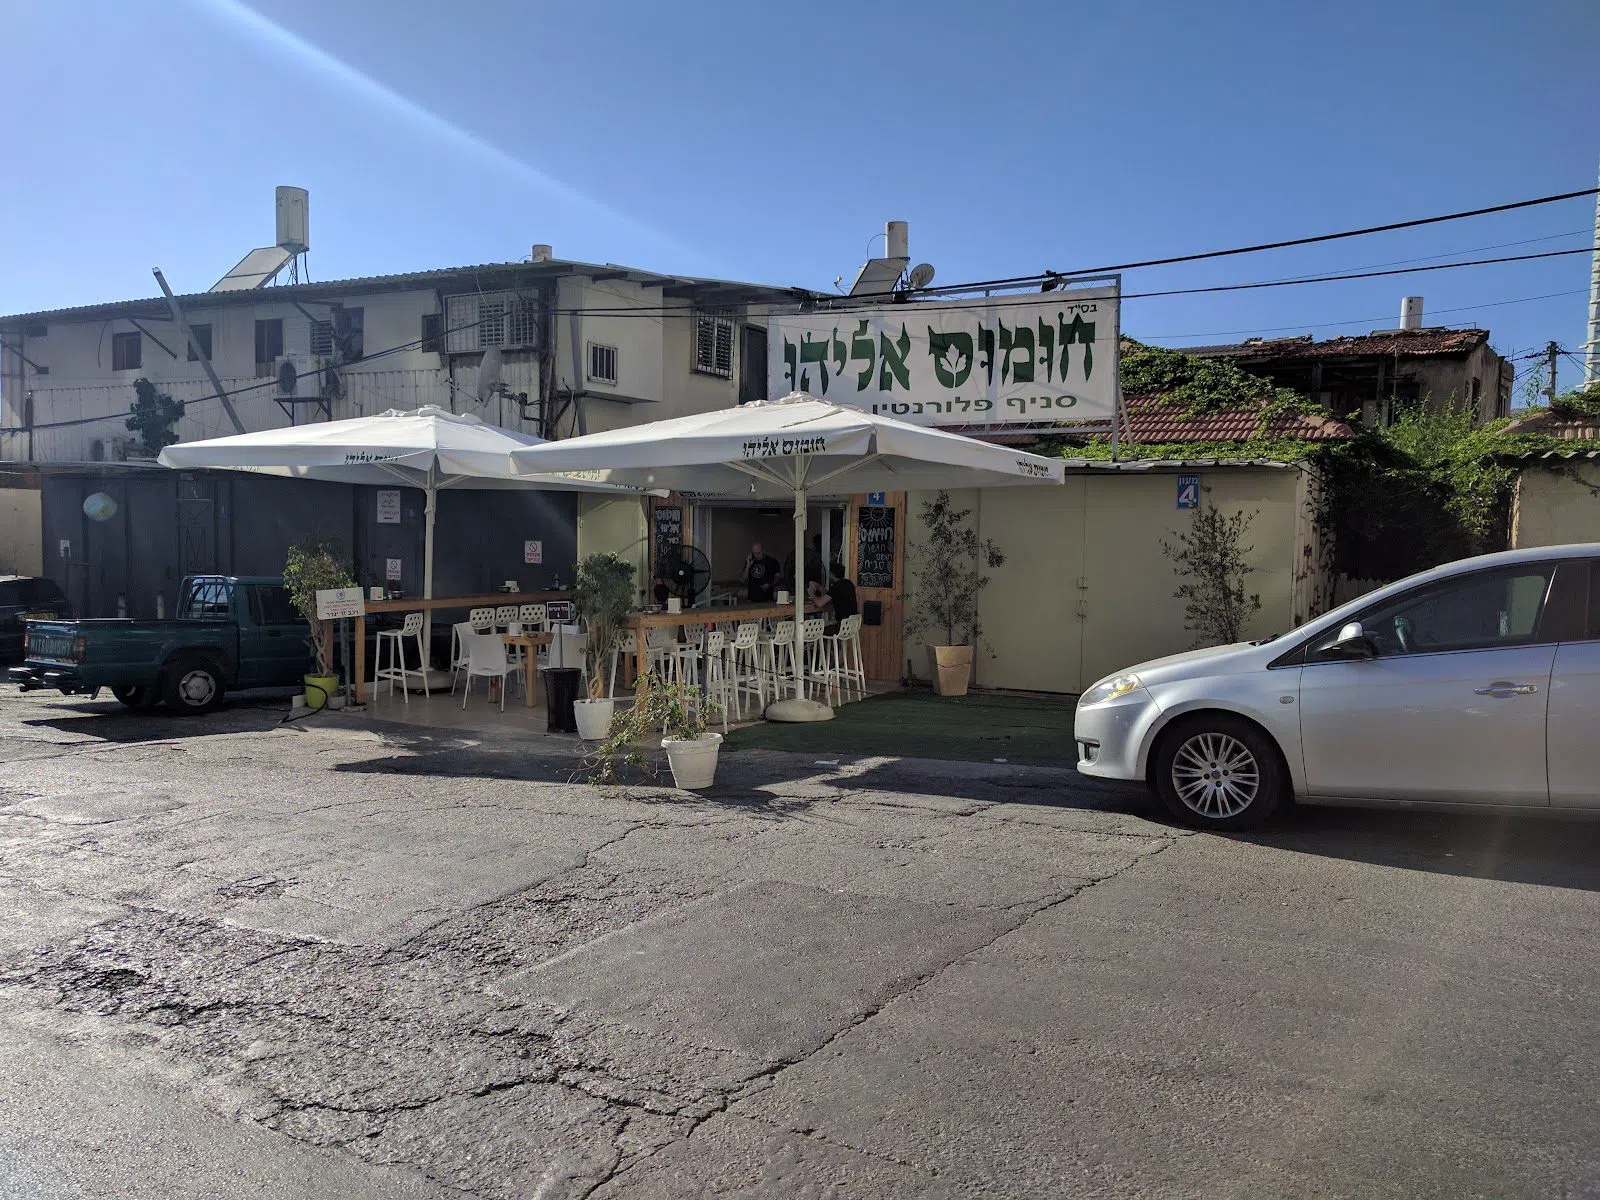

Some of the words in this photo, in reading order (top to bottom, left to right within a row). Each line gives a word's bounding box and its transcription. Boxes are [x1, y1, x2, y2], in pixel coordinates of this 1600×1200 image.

[1067, 304, 1098, 314] בס"ד
[784, 318, 911, 396] אליהו
[928, 311, 1096, 389] חומוס
[872, 397, 994, 415] פלורנטין
[1007, 395, 1077, 414] סניף
[743, 436, 779, 457] אליהו
[782, 436, 826, 455] חומוס
[1178, 477, 1199, 486] מעון
[872, 491, 881, 501] 4
[1178, 484, 1197, 507] 4
